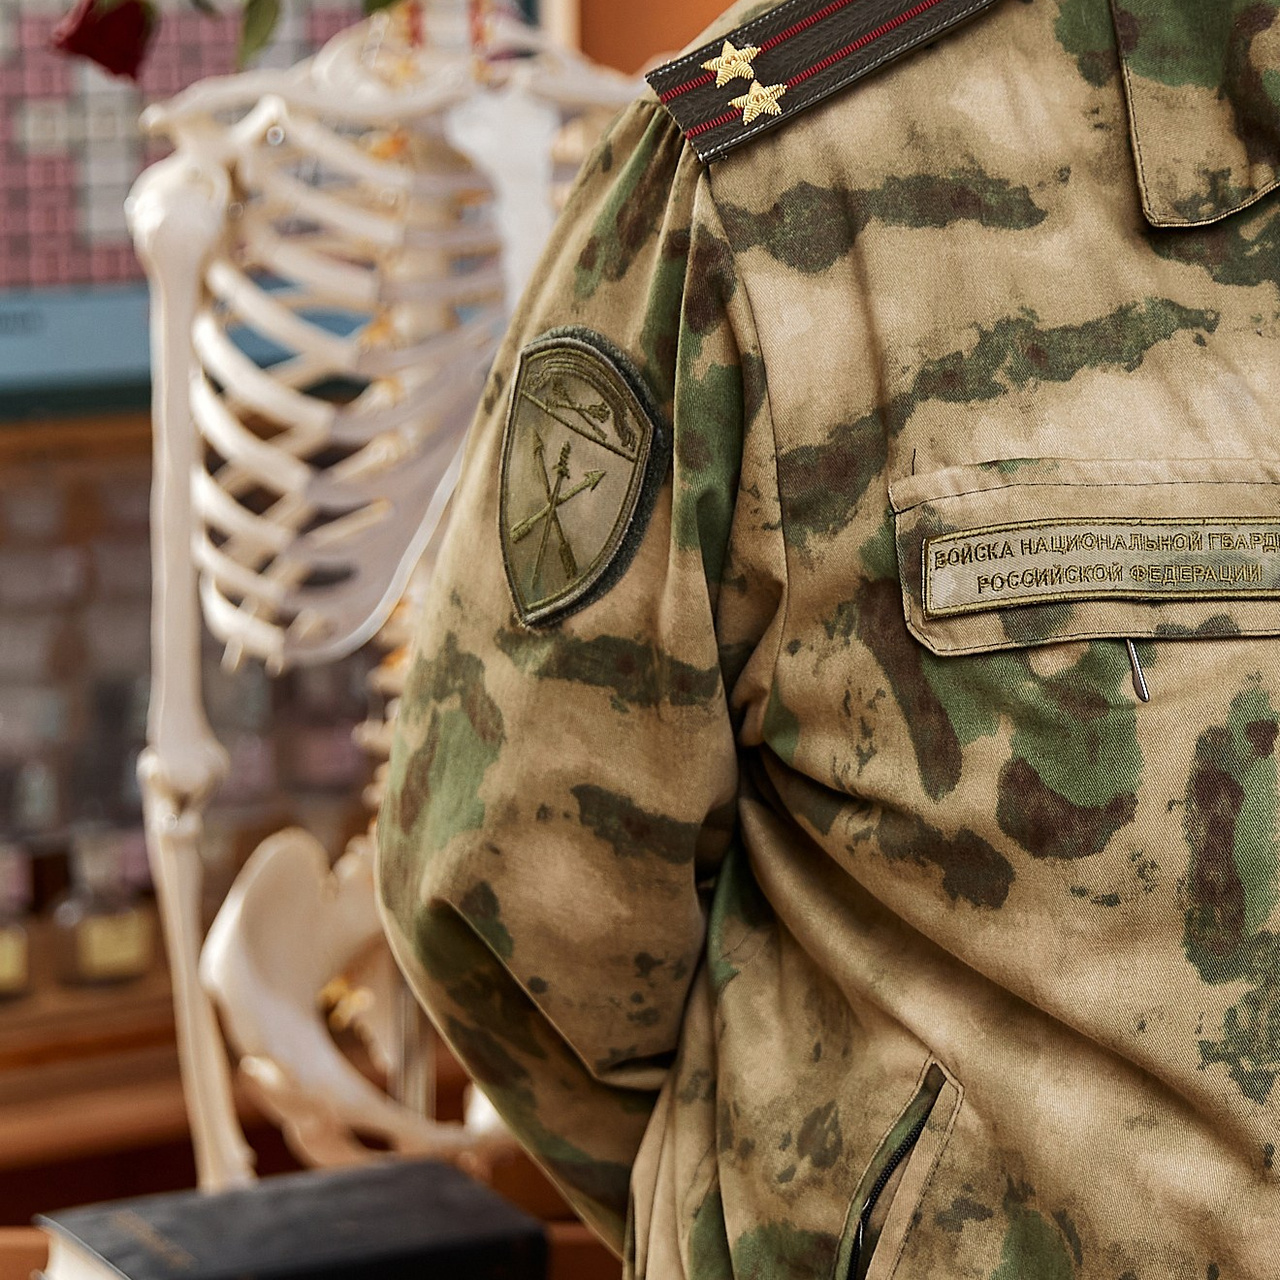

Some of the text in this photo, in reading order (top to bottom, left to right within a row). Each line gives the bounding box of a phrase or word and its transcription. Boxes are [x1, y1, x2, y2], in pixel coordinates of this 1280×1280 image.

[934, 540, 1015, 570] ВОЙСКА
[1020, 530, 1203, 556] НАЦИОНАЛЬНОЙ
[976, 561, 1262, 594] РОССИЙСКОЙ ФЕДЕРАЦИИ
